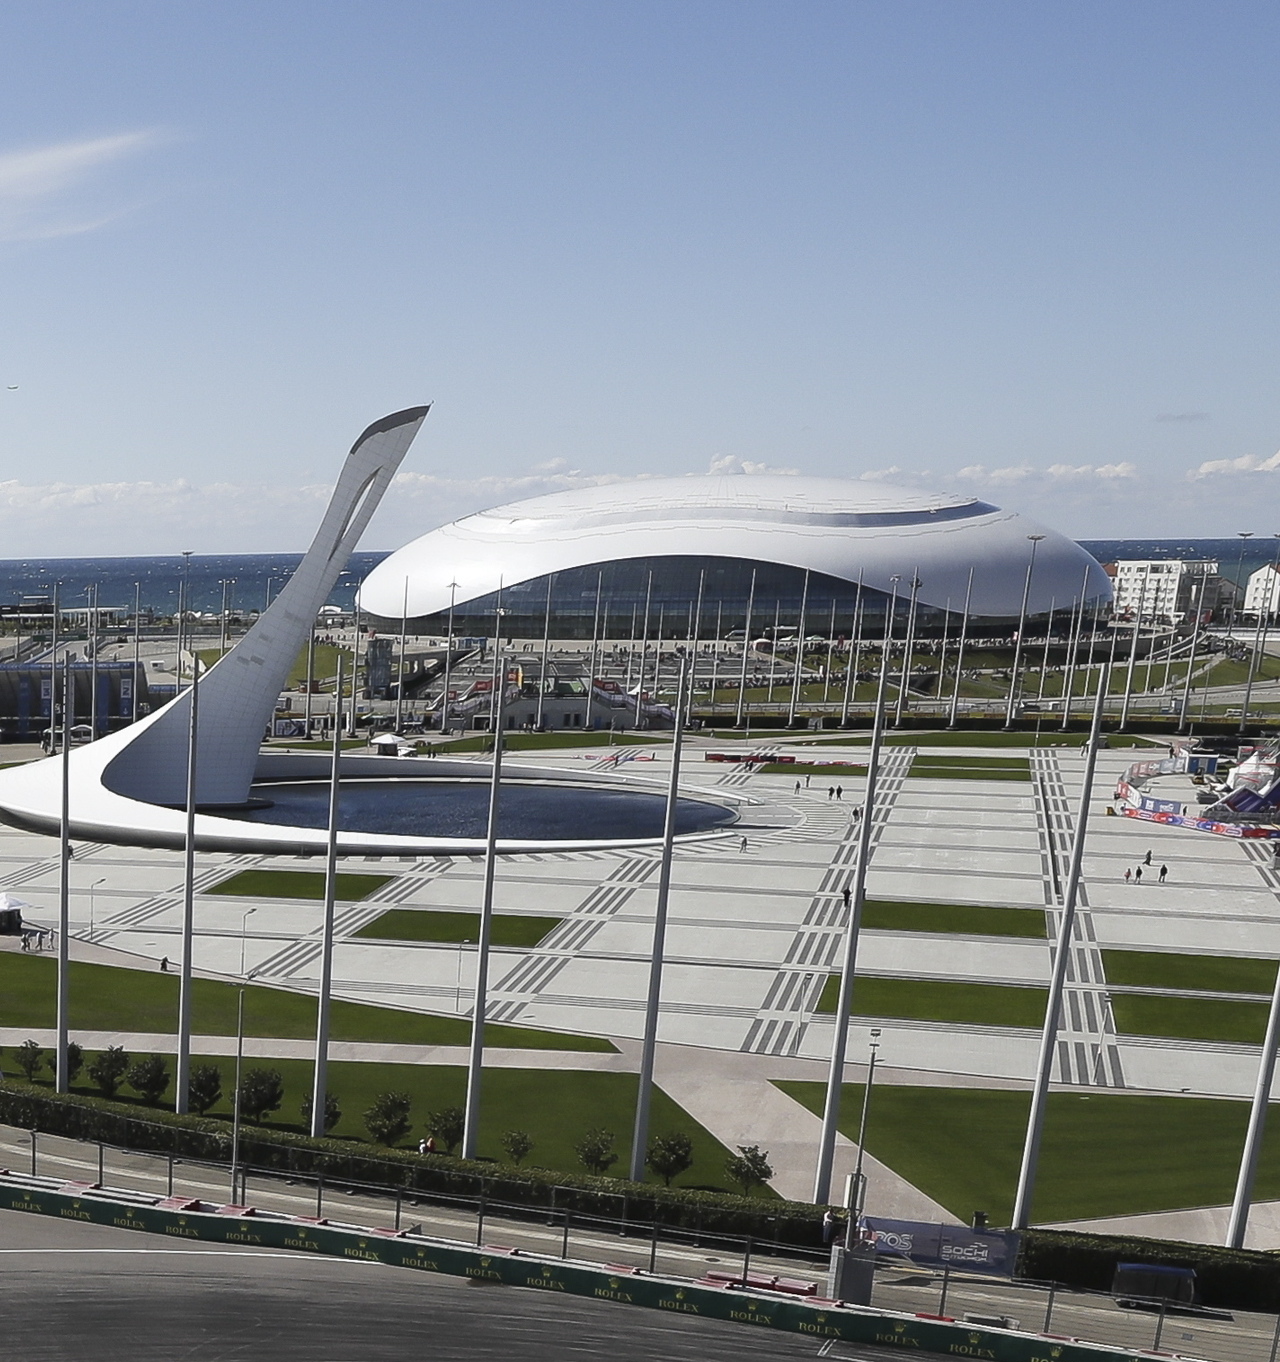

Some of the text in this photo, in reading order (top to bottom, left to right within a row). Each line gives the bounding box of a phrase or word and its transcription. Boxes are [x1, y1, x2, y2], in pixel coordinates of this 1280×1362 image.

[11, 1200, 41, 1211] ROLEX
[60, 1208, 90, 1219] ROLEX
[114, 1217, 145, 1228] ROLEX
[165, 1225, 199, 1236] ROLEX
[226, 1232, 261, 1243] ROLEX
[284, 1237, 319, 1249] ROLEX
[344, 1247, 379, 1259] ROLEX
[942, 1245, 989, 1258] SOCHI
[402, 1256, 438, 1270] ROLEX
[466, 1267, 502, 1280] ROLEX
[527, 1276, 564, 1290] ROLEX
[594, 1287, 632, 1302] ROLEX
[659, 1299, 699, 1313] ROLEX
[730, 1310, 771, 1324] ROLEX
[799, 1321, 842, 1336] ROLEX
[876, 1333, 919, 1347] ROLEX
[950, 1344, 995, 1359] ROLEX
